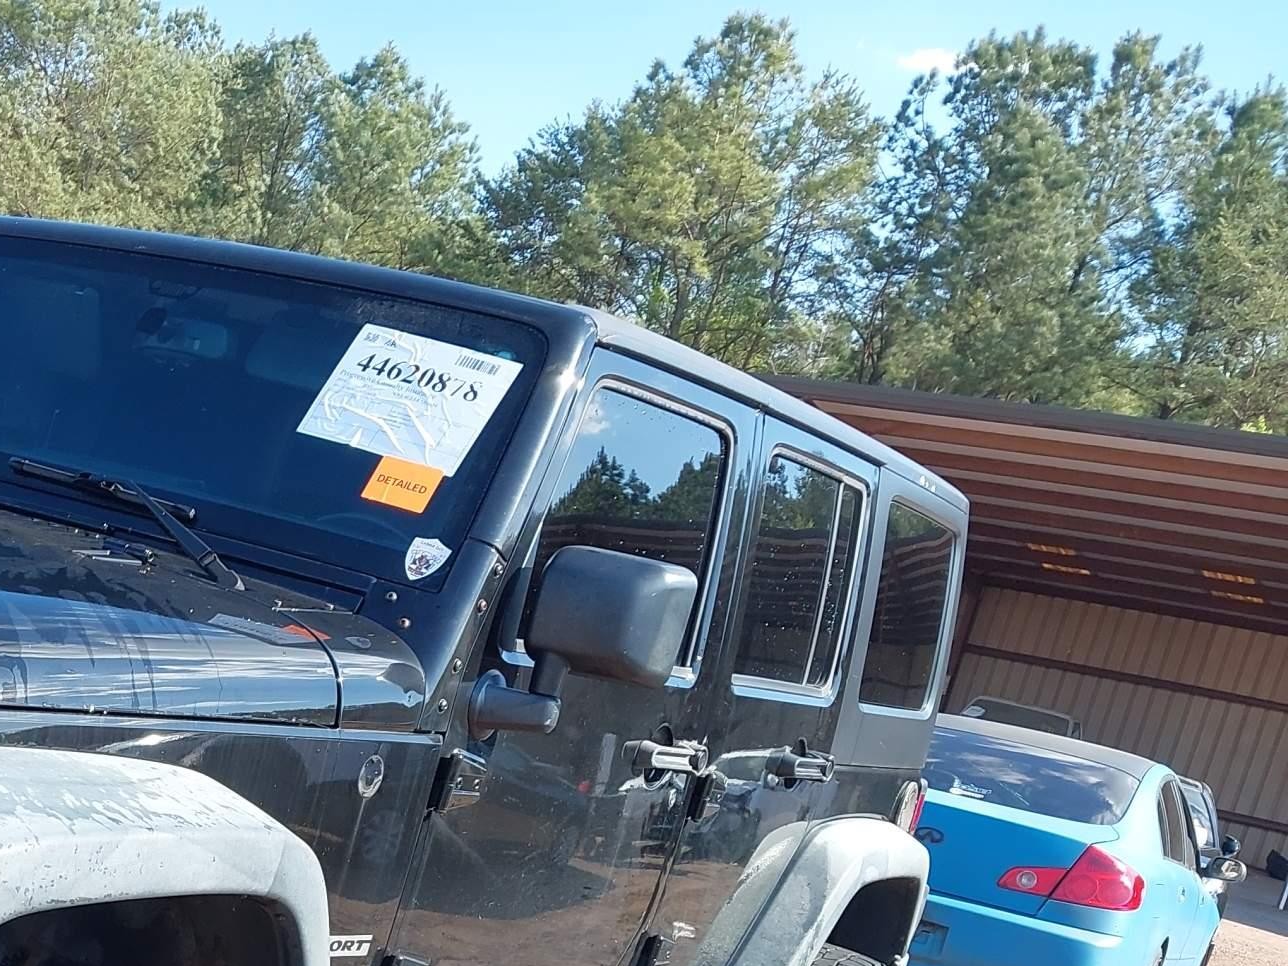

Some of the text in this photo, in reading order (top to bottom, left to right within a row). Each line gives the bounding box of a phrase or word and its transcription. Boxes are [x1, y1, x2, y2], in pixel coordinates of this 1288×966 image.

[356, 353, 484, 402] 44620878
[377, 473, 428, 494] DETAILED
[330, 939, 373, 953] ORT
